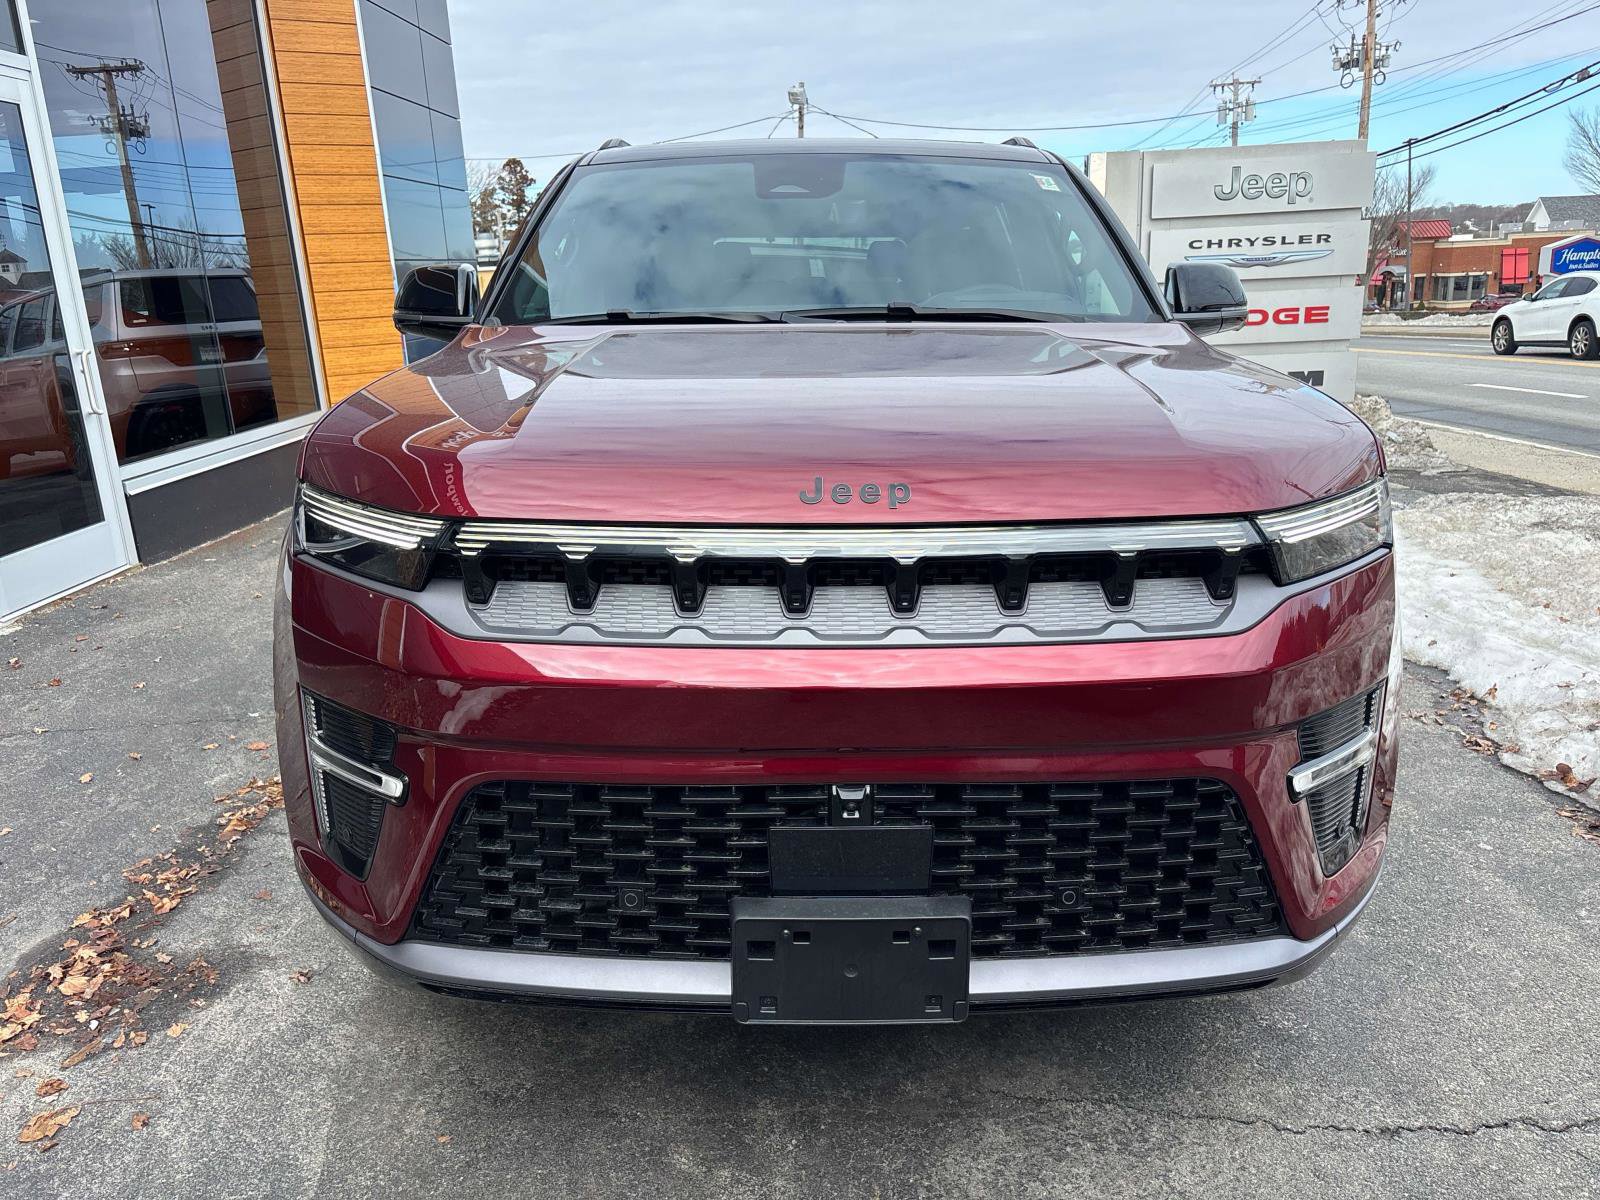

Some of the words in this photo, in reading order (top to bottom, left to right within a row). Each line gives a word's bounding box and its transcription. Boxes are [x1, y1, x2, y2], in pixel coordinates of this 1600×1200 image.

[1214, 166, 1313, 204] Jeep
[1188, 233, 1332, 249] CHRYSLER
[1556, 248, 1600, 265] Hampto
[1246, 306, 1330, 326] DGE
[799, 476, 911, 509] Jeep
